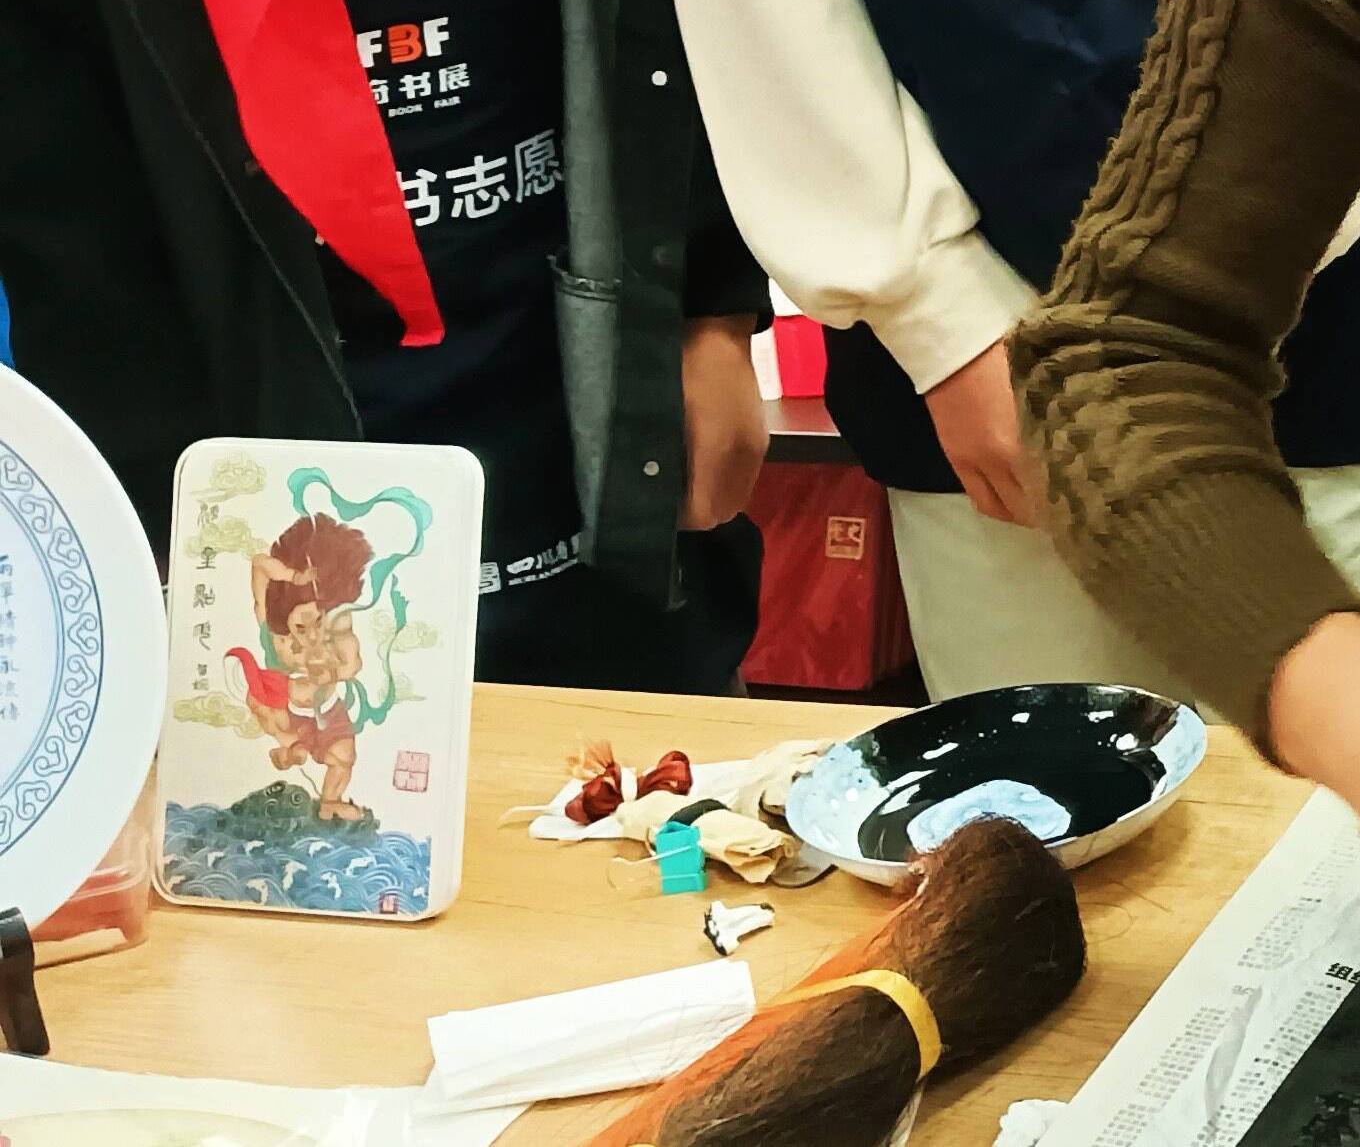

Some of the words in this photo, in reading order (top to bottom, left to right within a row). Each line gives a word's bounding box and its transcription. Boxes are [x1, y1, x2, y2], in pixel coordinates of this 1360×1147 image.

[356, 16, 450, 69] FBF
[388, 103, 423, 118] BOOK
[434, 96, 461, 109] FAIR
